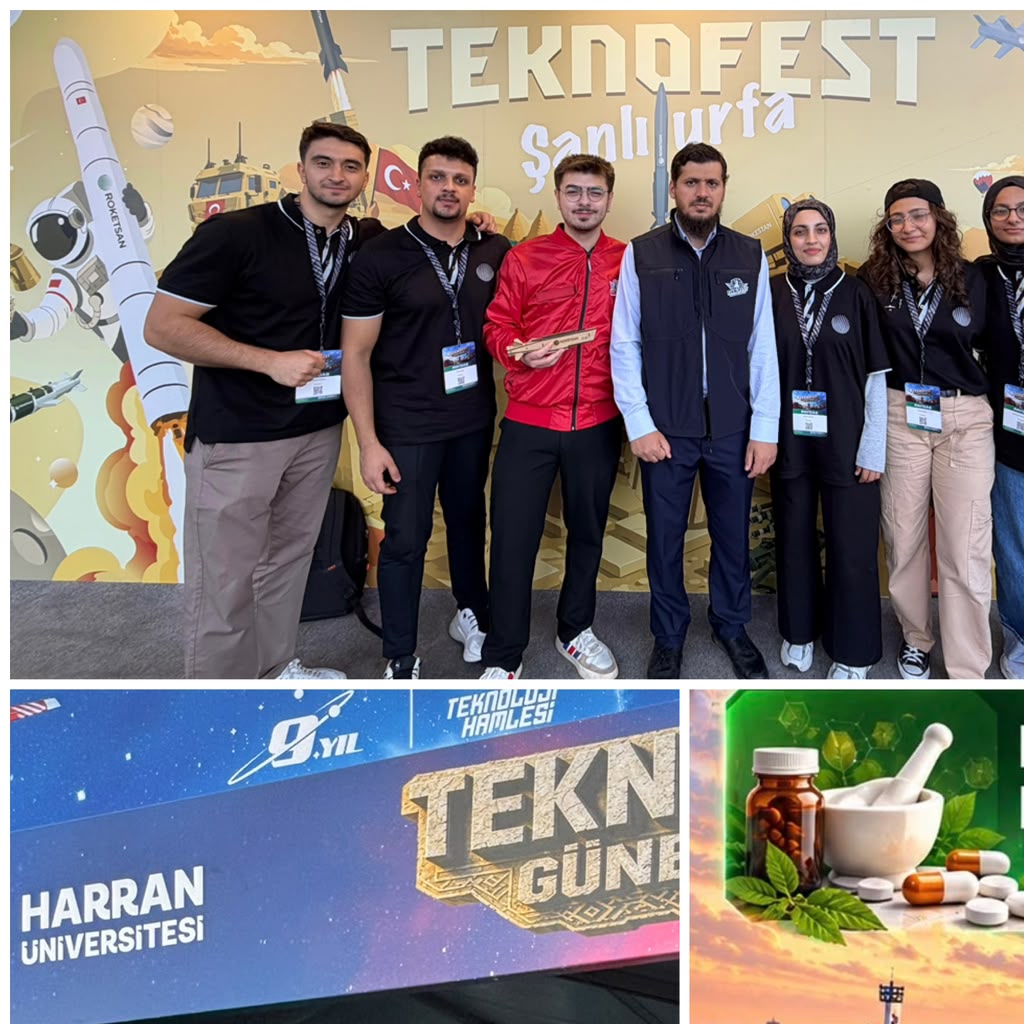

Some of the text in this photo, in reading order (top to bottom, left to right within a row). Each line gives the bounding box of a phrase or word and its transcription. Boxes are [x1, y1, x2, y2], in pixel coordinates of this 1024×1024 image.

[390, 17, 936, 114] TEKNOFEST
[104, 192, 127, 249] ROKETSAN
[460, 702, 555, 738] HAMLESİ
[21, 865, 204, 933] HARRAN
[21, 914, 204, 966] ÜNİVERSİTESİ
